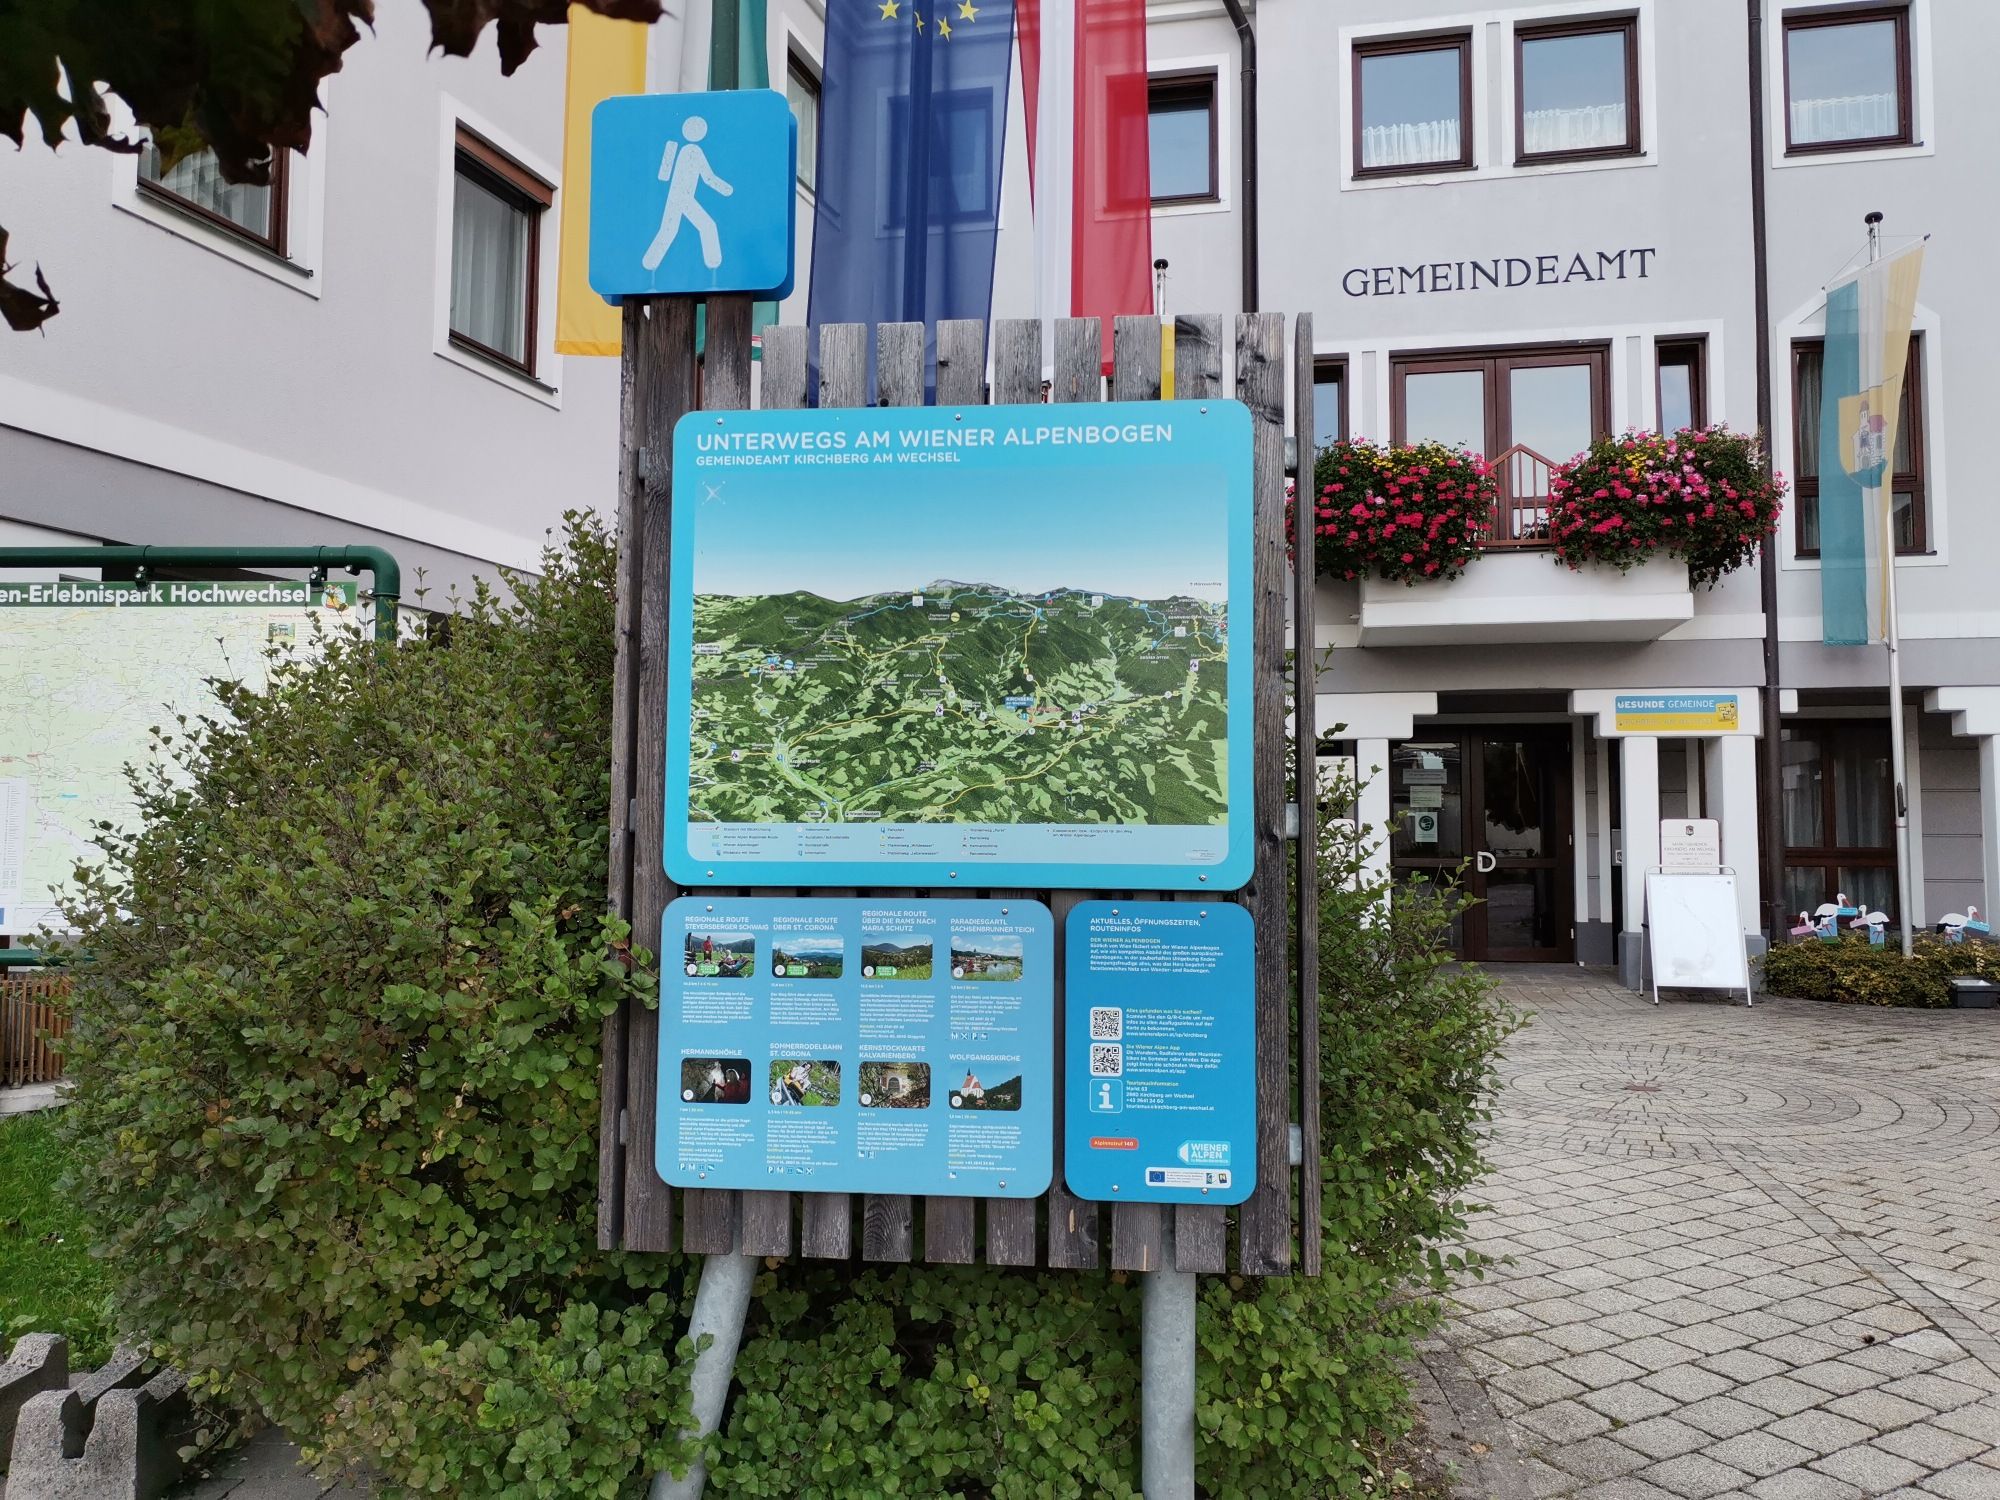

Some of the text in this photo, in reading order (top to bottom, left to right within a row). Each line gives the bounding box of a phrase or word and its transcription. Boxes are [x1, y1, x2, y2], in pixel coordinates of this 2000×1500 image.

[1342, 247, 1656, 297] GEMEINDEAMT
[697, 424, 1172, 451] UNTERWEGS AM WIENER ALPENBOGEN
[696, 451, 961, 466] GEMEINDEAMT KIRCHBERG AM WECHSEL
[0, 583, 311, 607] en-Erlebnispark Hochwechsel
[1667, 699, 1715, 708] GEMEINDE
[862, 916, 881, 924] ÜBER
[1090, 917, 1201, 927] AKTUELLES, ÖFFNUNGSZEITEN,
[773, 923, 792, 931] ÜBER
[681, 1047, 743, 1056] HERMANNSHÖHLE
[859, 1044, 926, 1052] KERNSTOCKWARTE
[949, 1053, 1021, 1062] WOLFGANGSKIRCHE
[1190, 1143, 1229, 1152] WIENER
[1190, 1151, 1223, 1159] ALPEN
